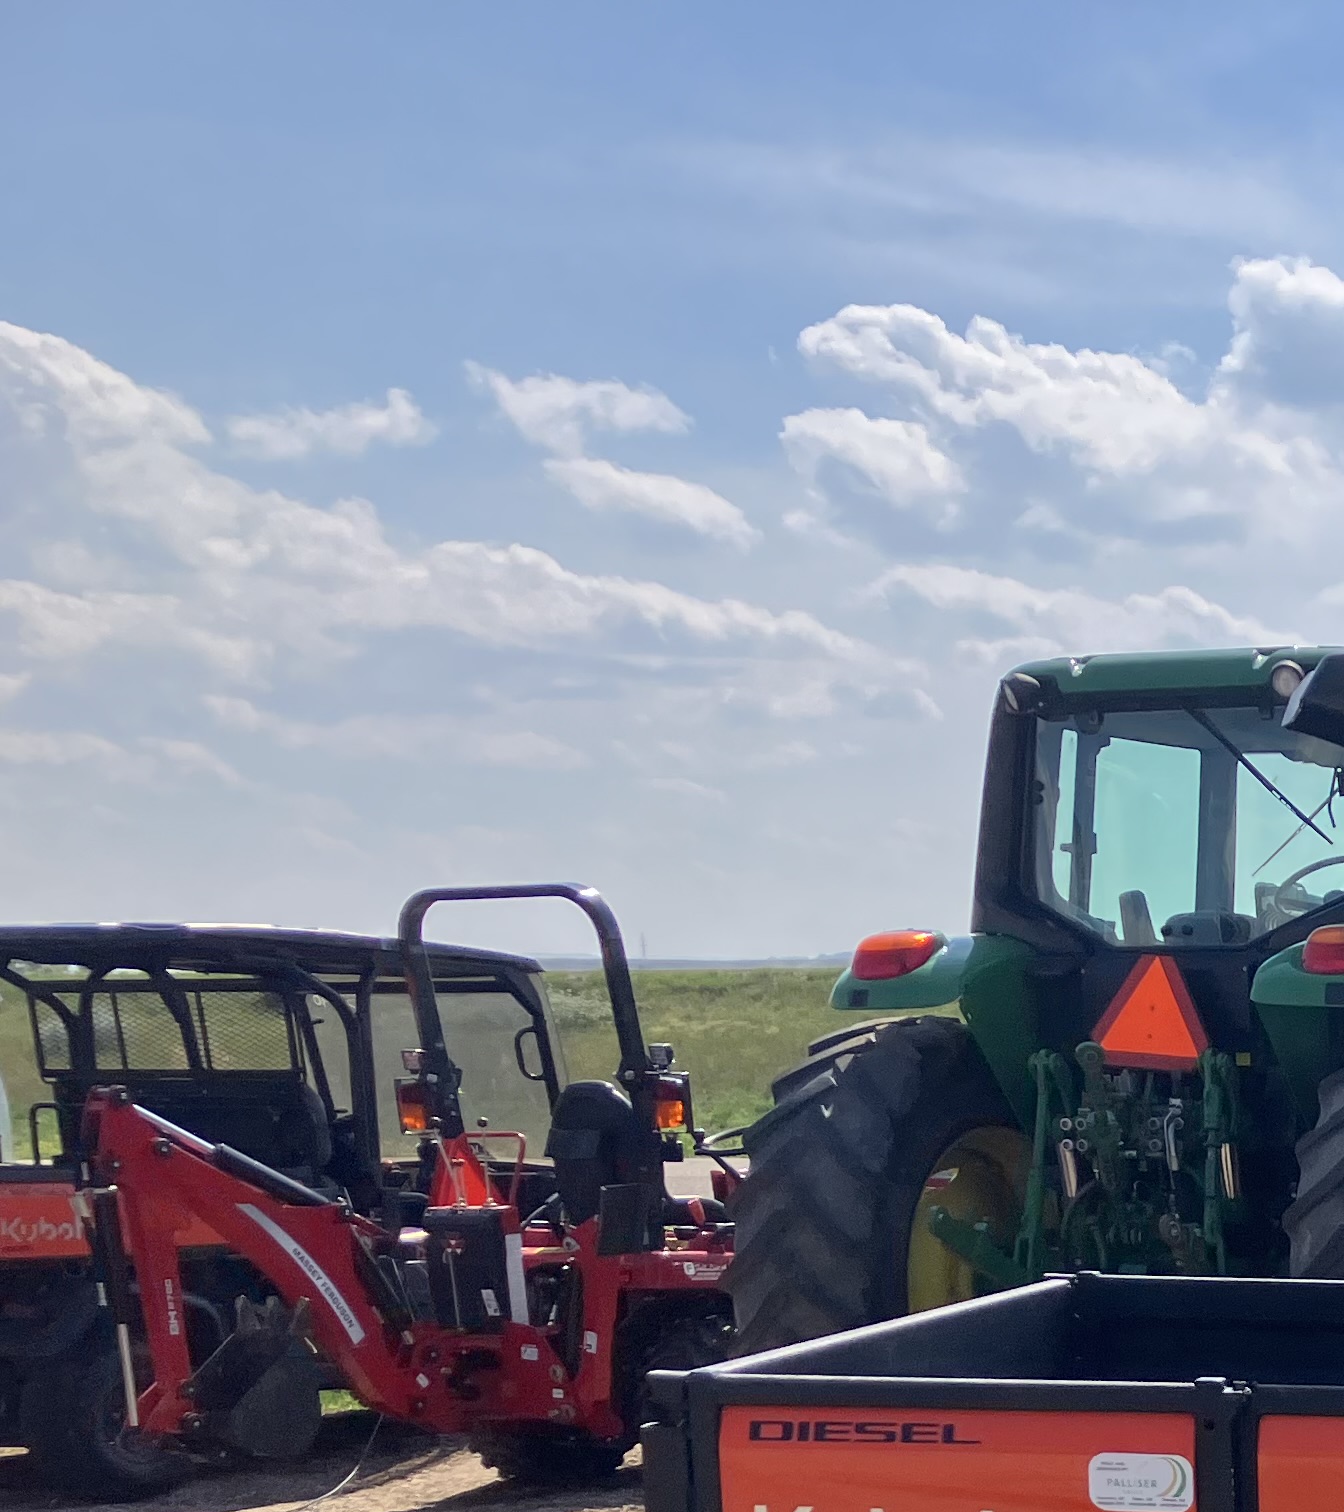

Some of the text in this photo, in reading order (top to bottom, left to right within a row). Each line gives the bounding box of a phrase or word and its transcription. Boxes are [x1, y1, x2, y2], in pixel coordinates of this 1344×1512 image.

[1, 1217, 84, 1242] Kubot
[292, 1247, 355, 1328] MASSEY FERGUSON
[750, 1420, 982, 1445] DIESEL
[1106, 1478, 1158, 1488] PALLISER
